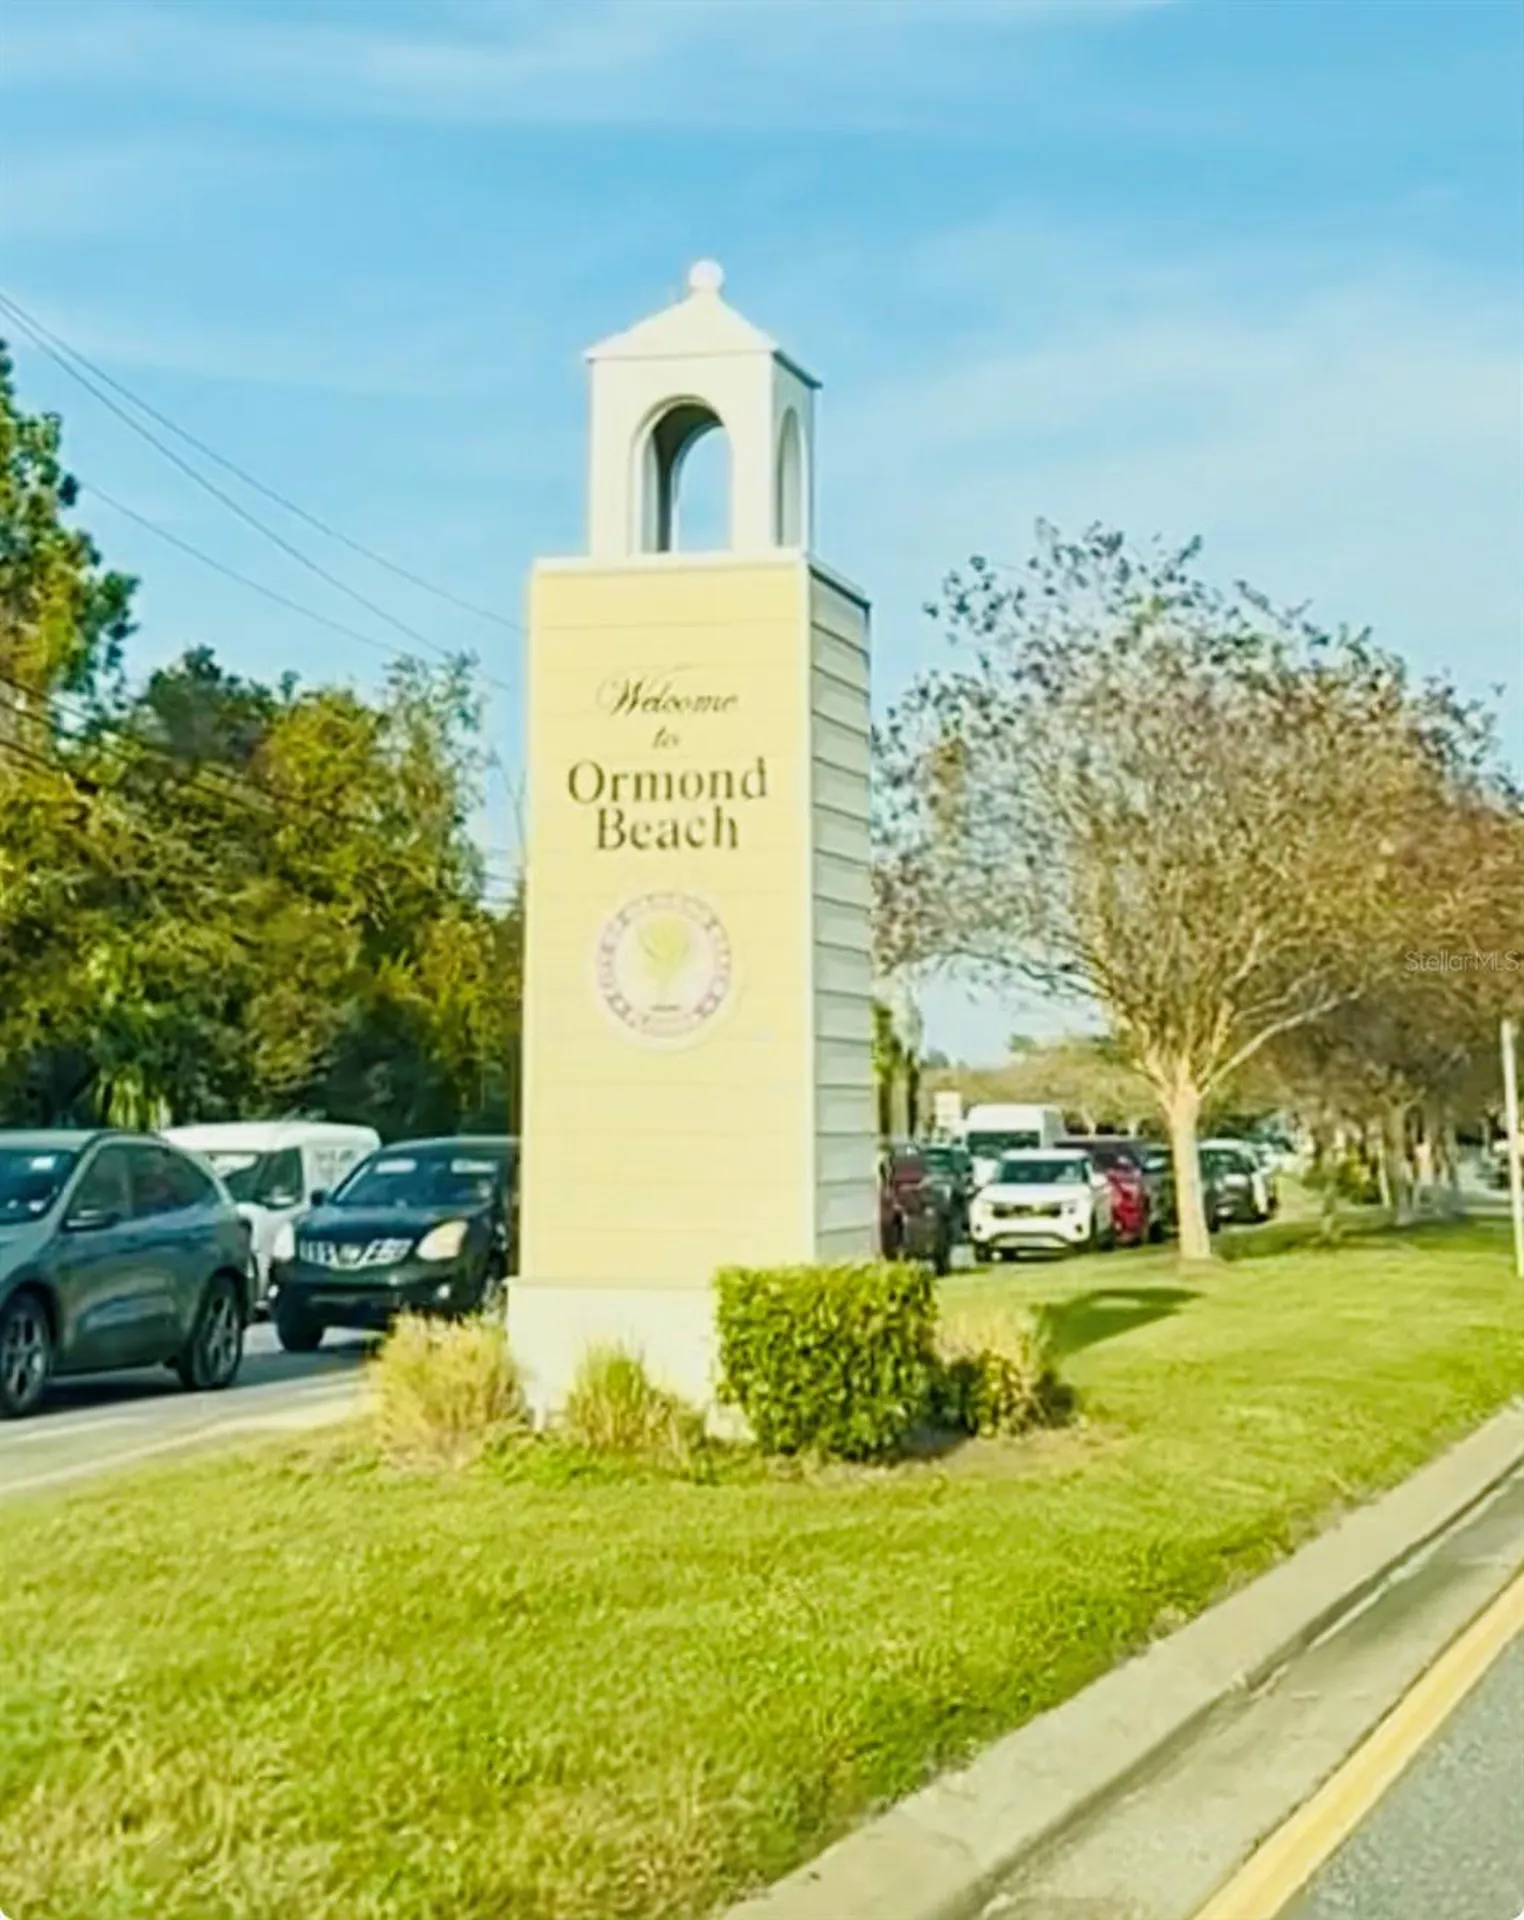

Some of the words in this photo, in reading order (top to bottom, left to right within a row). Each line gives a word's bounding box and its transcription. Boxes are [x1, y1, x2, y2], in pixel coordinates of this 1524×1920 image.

[597, 668, 739, 716] Welcome
[652, 726, 681, 749] to
[567, 756, 768, 804] Ormond
[597, 804, 739, 850] Beach
